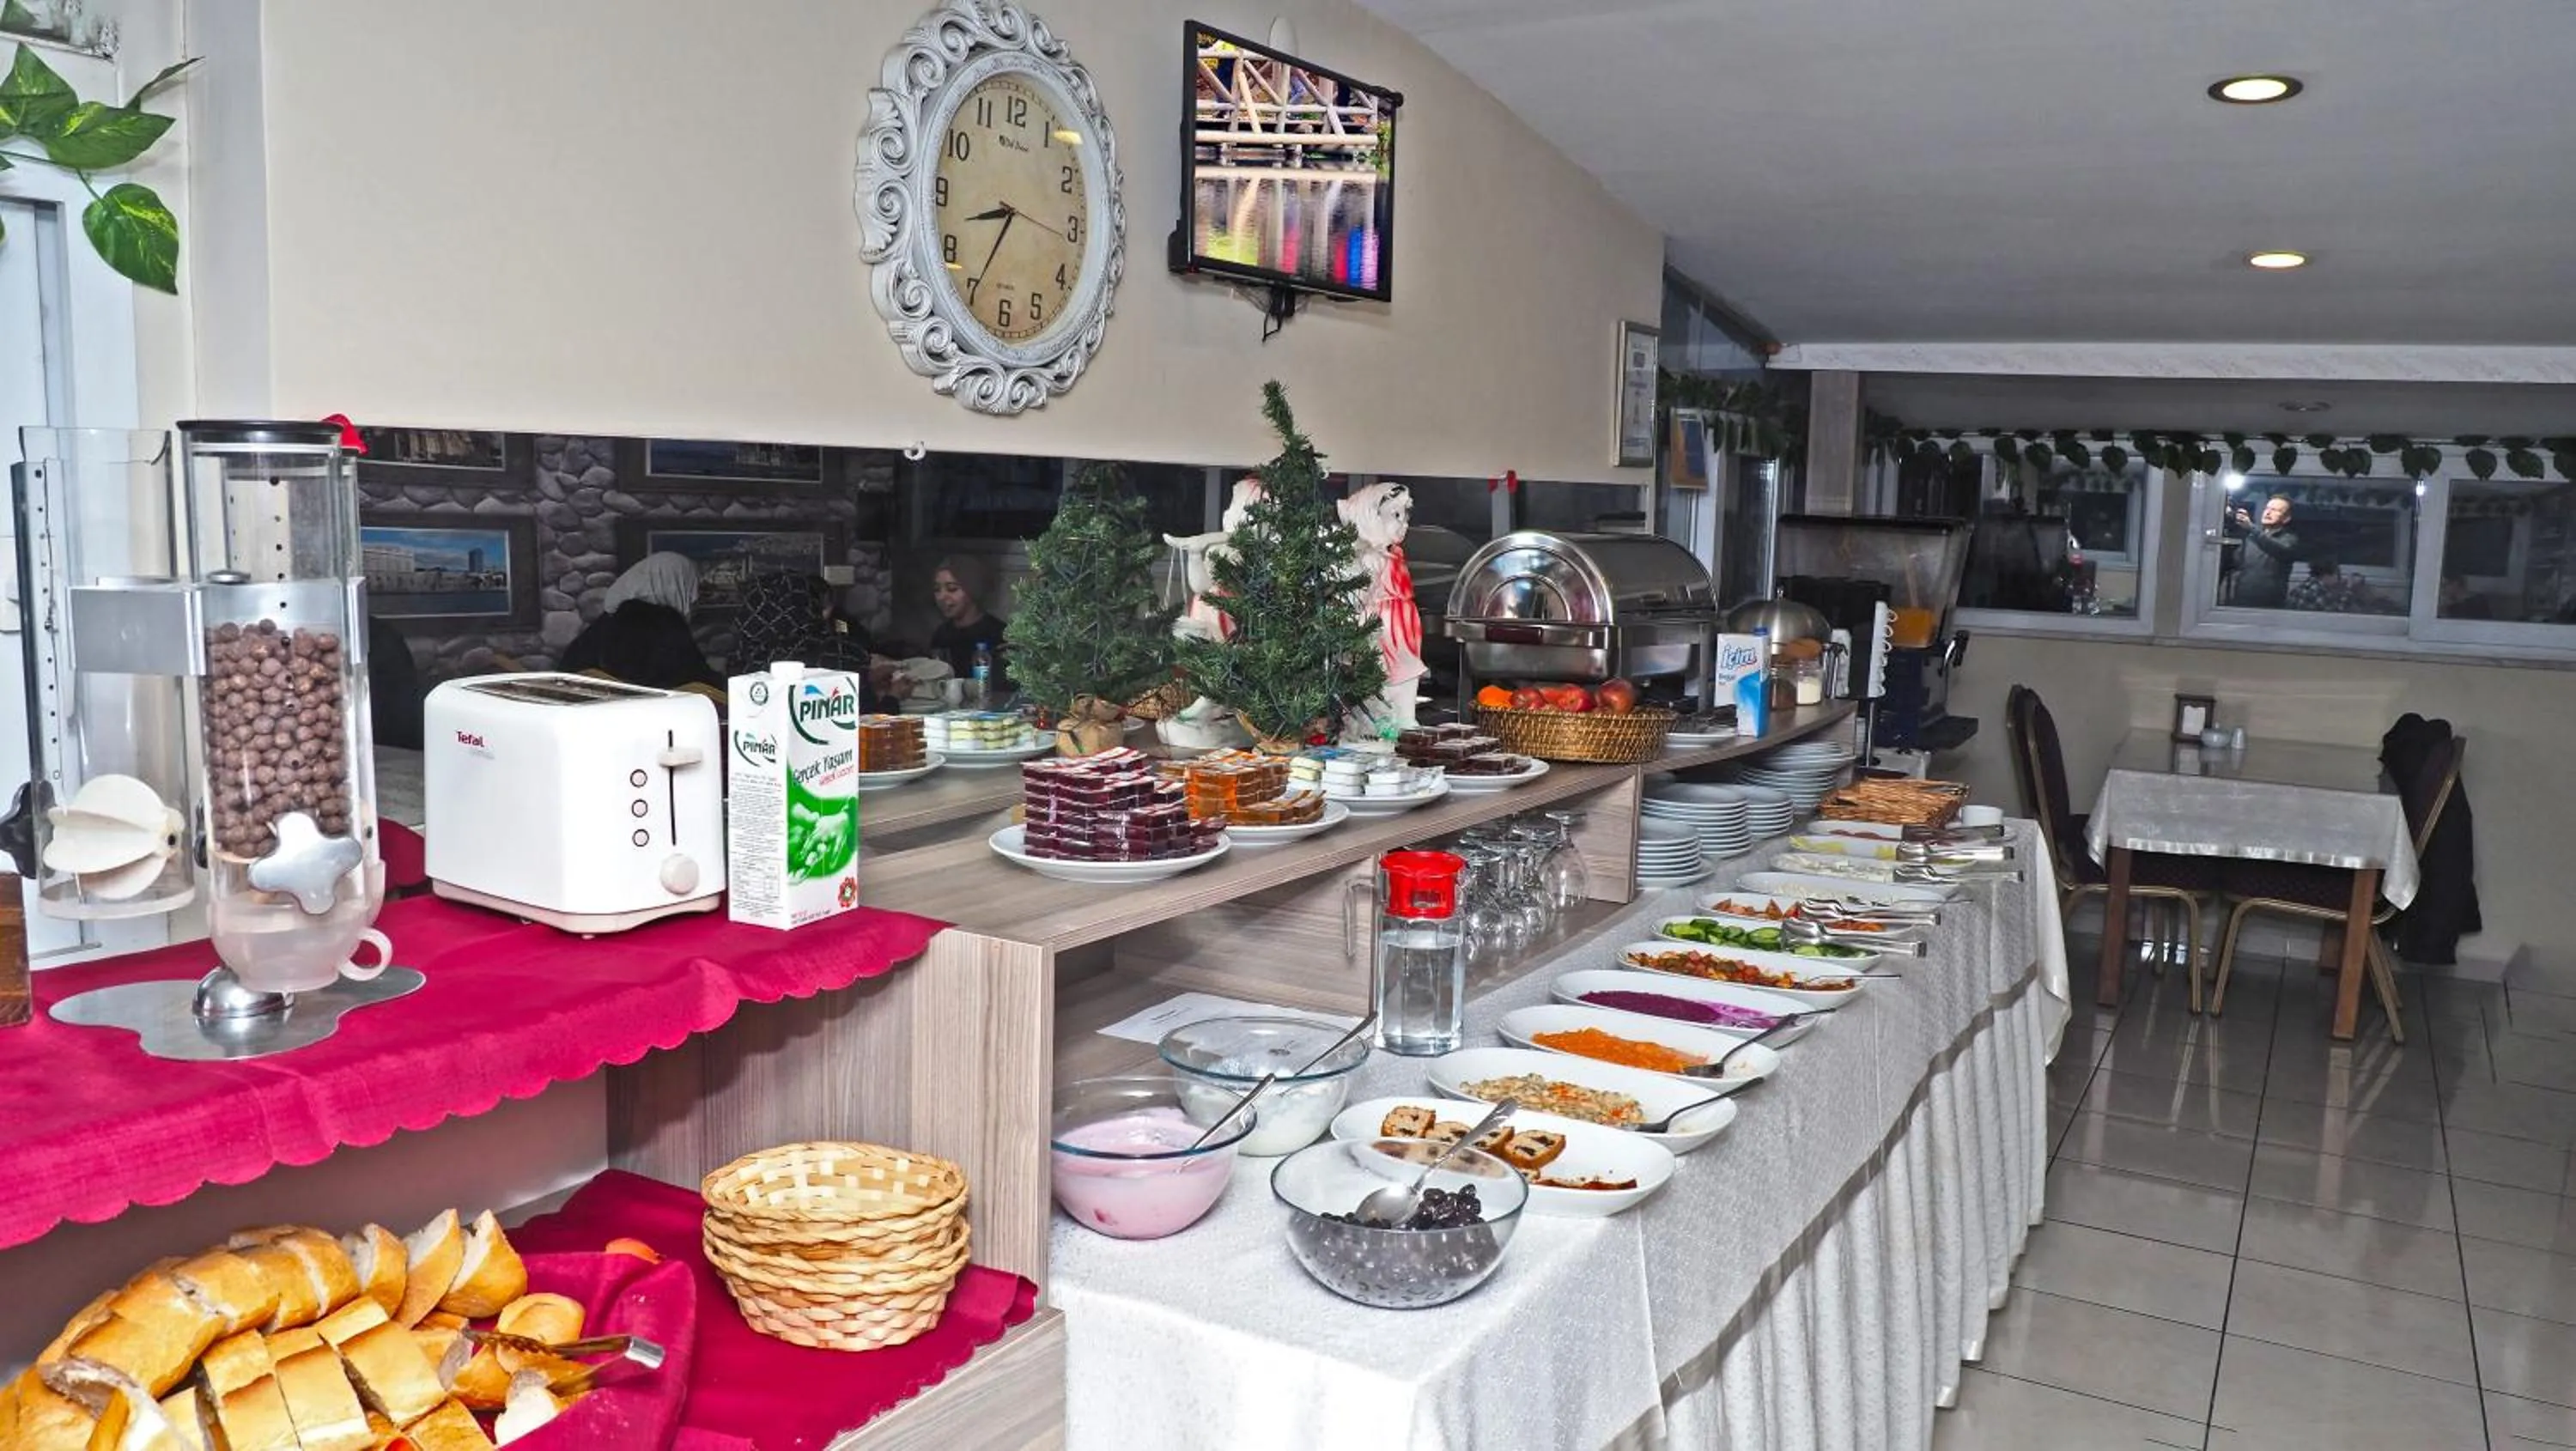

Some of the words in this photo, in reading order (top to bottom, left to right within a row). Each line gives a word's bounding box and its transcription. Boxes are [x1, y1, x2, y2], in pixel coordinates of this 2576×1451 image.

[976, 97, 992, 129] 11
[1005, 95, 1027, 129] 12
[947, 128, 969, 161] 10
[1044, 121, 1049, 148] 1
[935, 176, 948, 206] 9
[1061, 166, 1072, 194] 2
[1067, 216, 1078, 243] 3
[944, 234, 957, 263] 8
[1055, 263, 1066, 290] 4
[967, 277, 980, 307] 7
[998, 300, 1011, 327] 6
[1030, 293, 1042, 320] 5
[457, 731, 485, 748] Tefal
